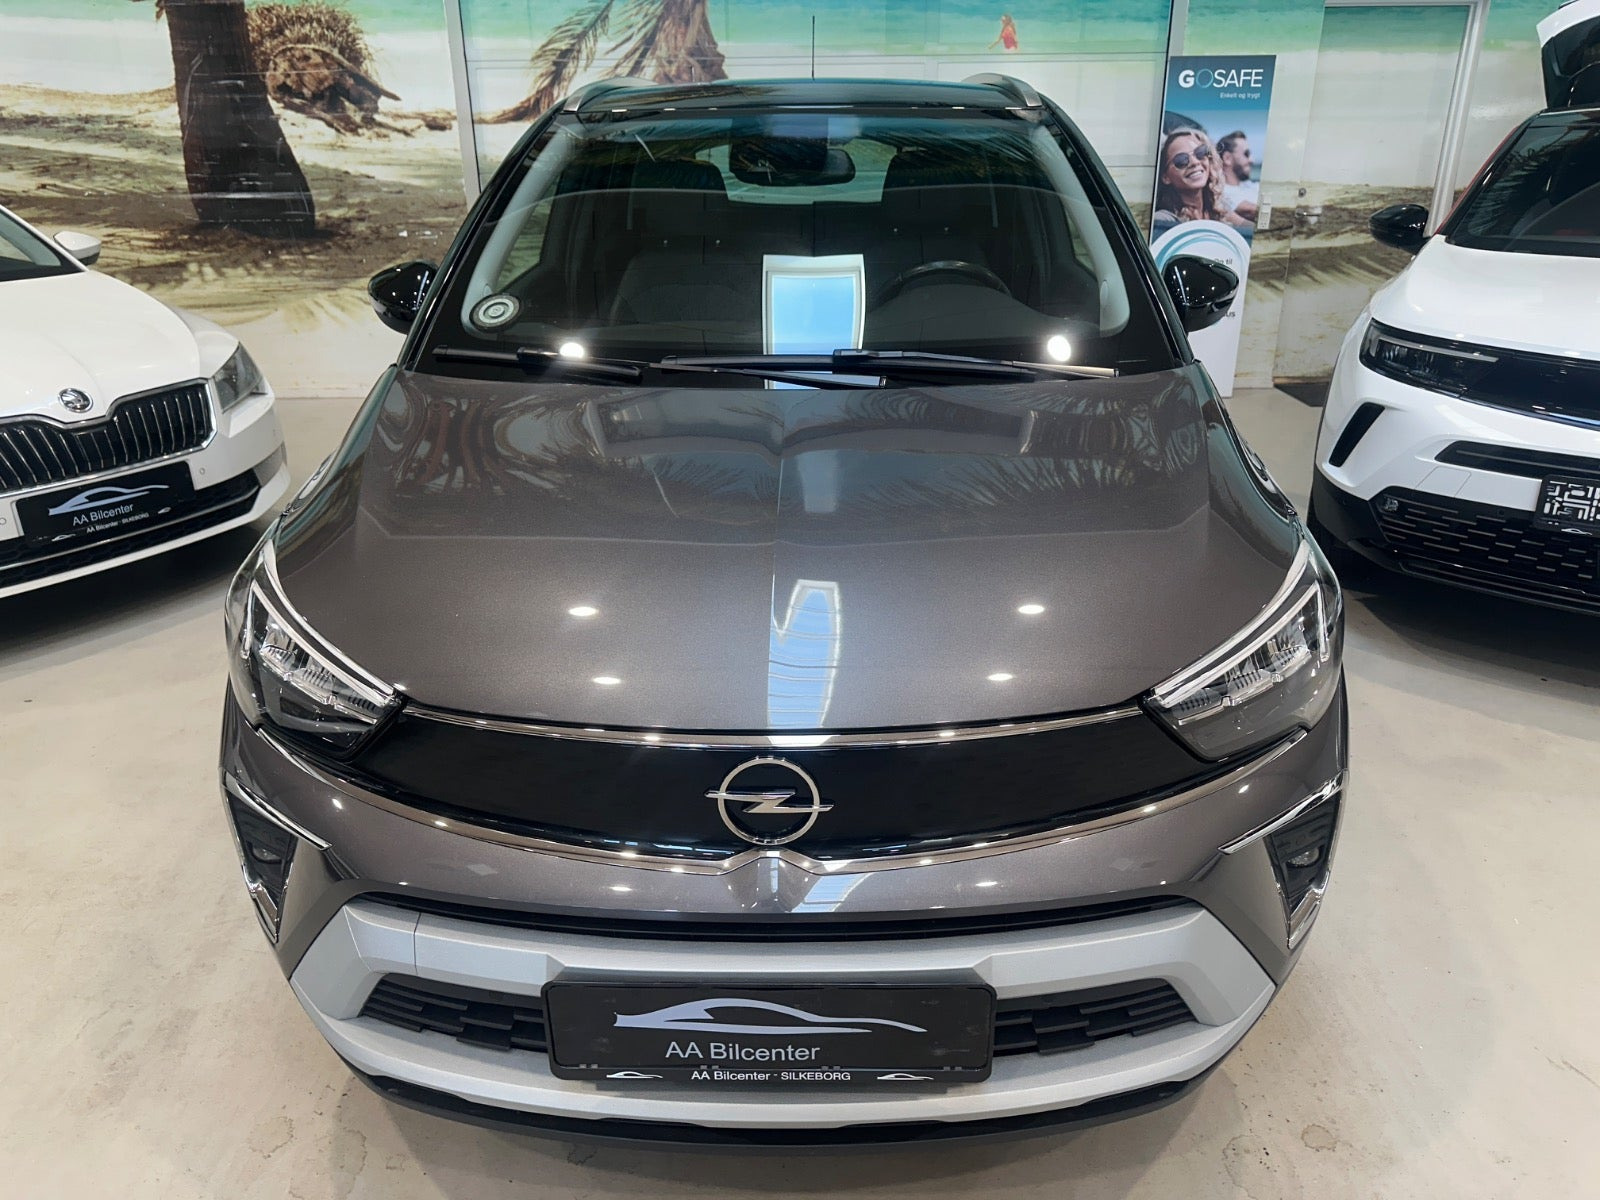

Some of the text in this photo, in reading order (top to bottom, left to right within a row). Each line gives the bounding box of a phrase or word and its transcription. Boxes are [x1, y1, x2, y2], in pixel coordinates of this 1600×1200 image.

[1178, 68, 1264, 88] GOSAFE
[72, 504, 134, 526] AA Bilcenter
[86, 526, 96, 534] AA
[665, 1041, 820, 1061] AA Bilcenter
[691, 1070, 710, 1080] AA
[714, 1070, 770, 1081] Bilcenter
[781, 1072, 851, 1081] SILKEBORG
